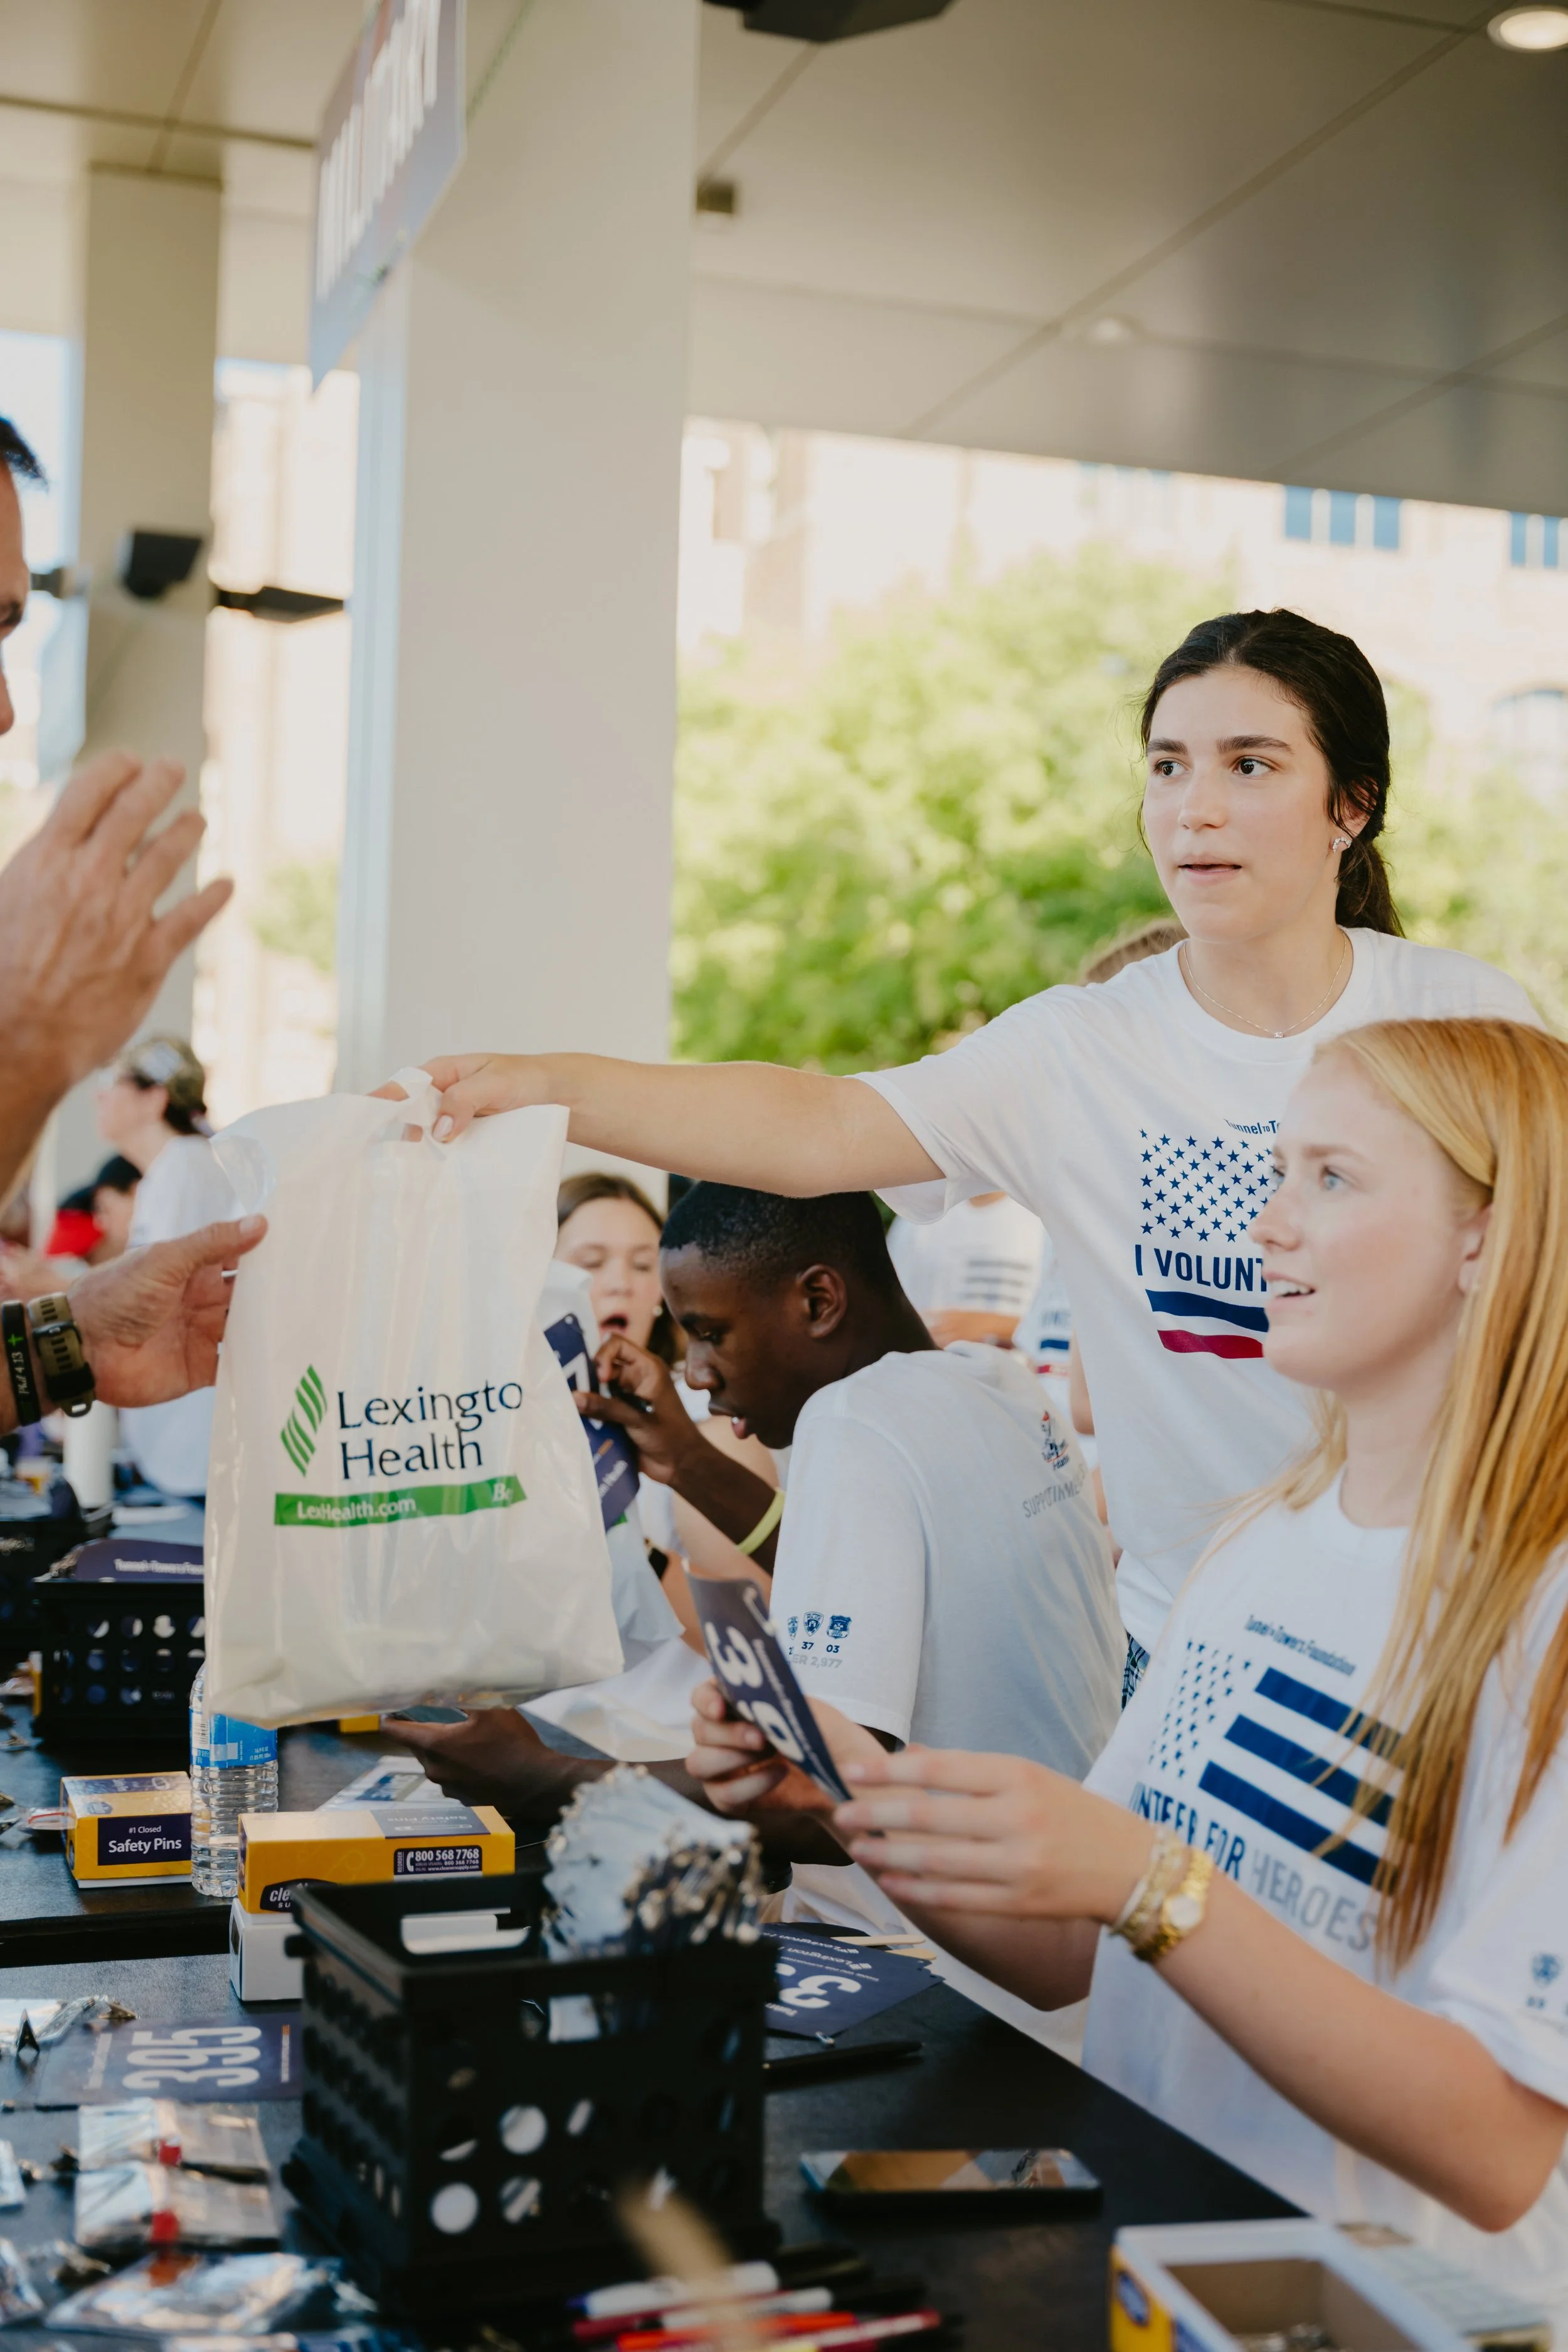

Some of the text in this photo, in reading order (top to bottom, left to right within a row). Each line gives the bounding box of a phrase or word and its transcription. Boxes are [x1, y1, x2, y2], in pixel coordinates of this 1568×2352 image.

[1135, 1244, 1143, 1276] I
[337, 1379, 522, 1432] Lexingto
[341, 1421, 483, 1480] Health
[297, 1498, 418, 1522] LexHealth.com
[802, 1641, 815, 1650] 37
[826, 1645, 840, 1653] 03
[810, 1656, 844, 1669] 2,977
[137, 1825, 162, 1834] Closed
[109, 1837, 182, 1855] Safety Pins
[415, 1850, 434, 1862] 800
[435, 1849, 454, 1861] 568
[455, 1848, 480, 1860] 7768
[1253, 1848, 1377, 1951] HEROES
[787, 1947, 854, 1965] Lexington
[122, 2026, 262, 2090] 395
